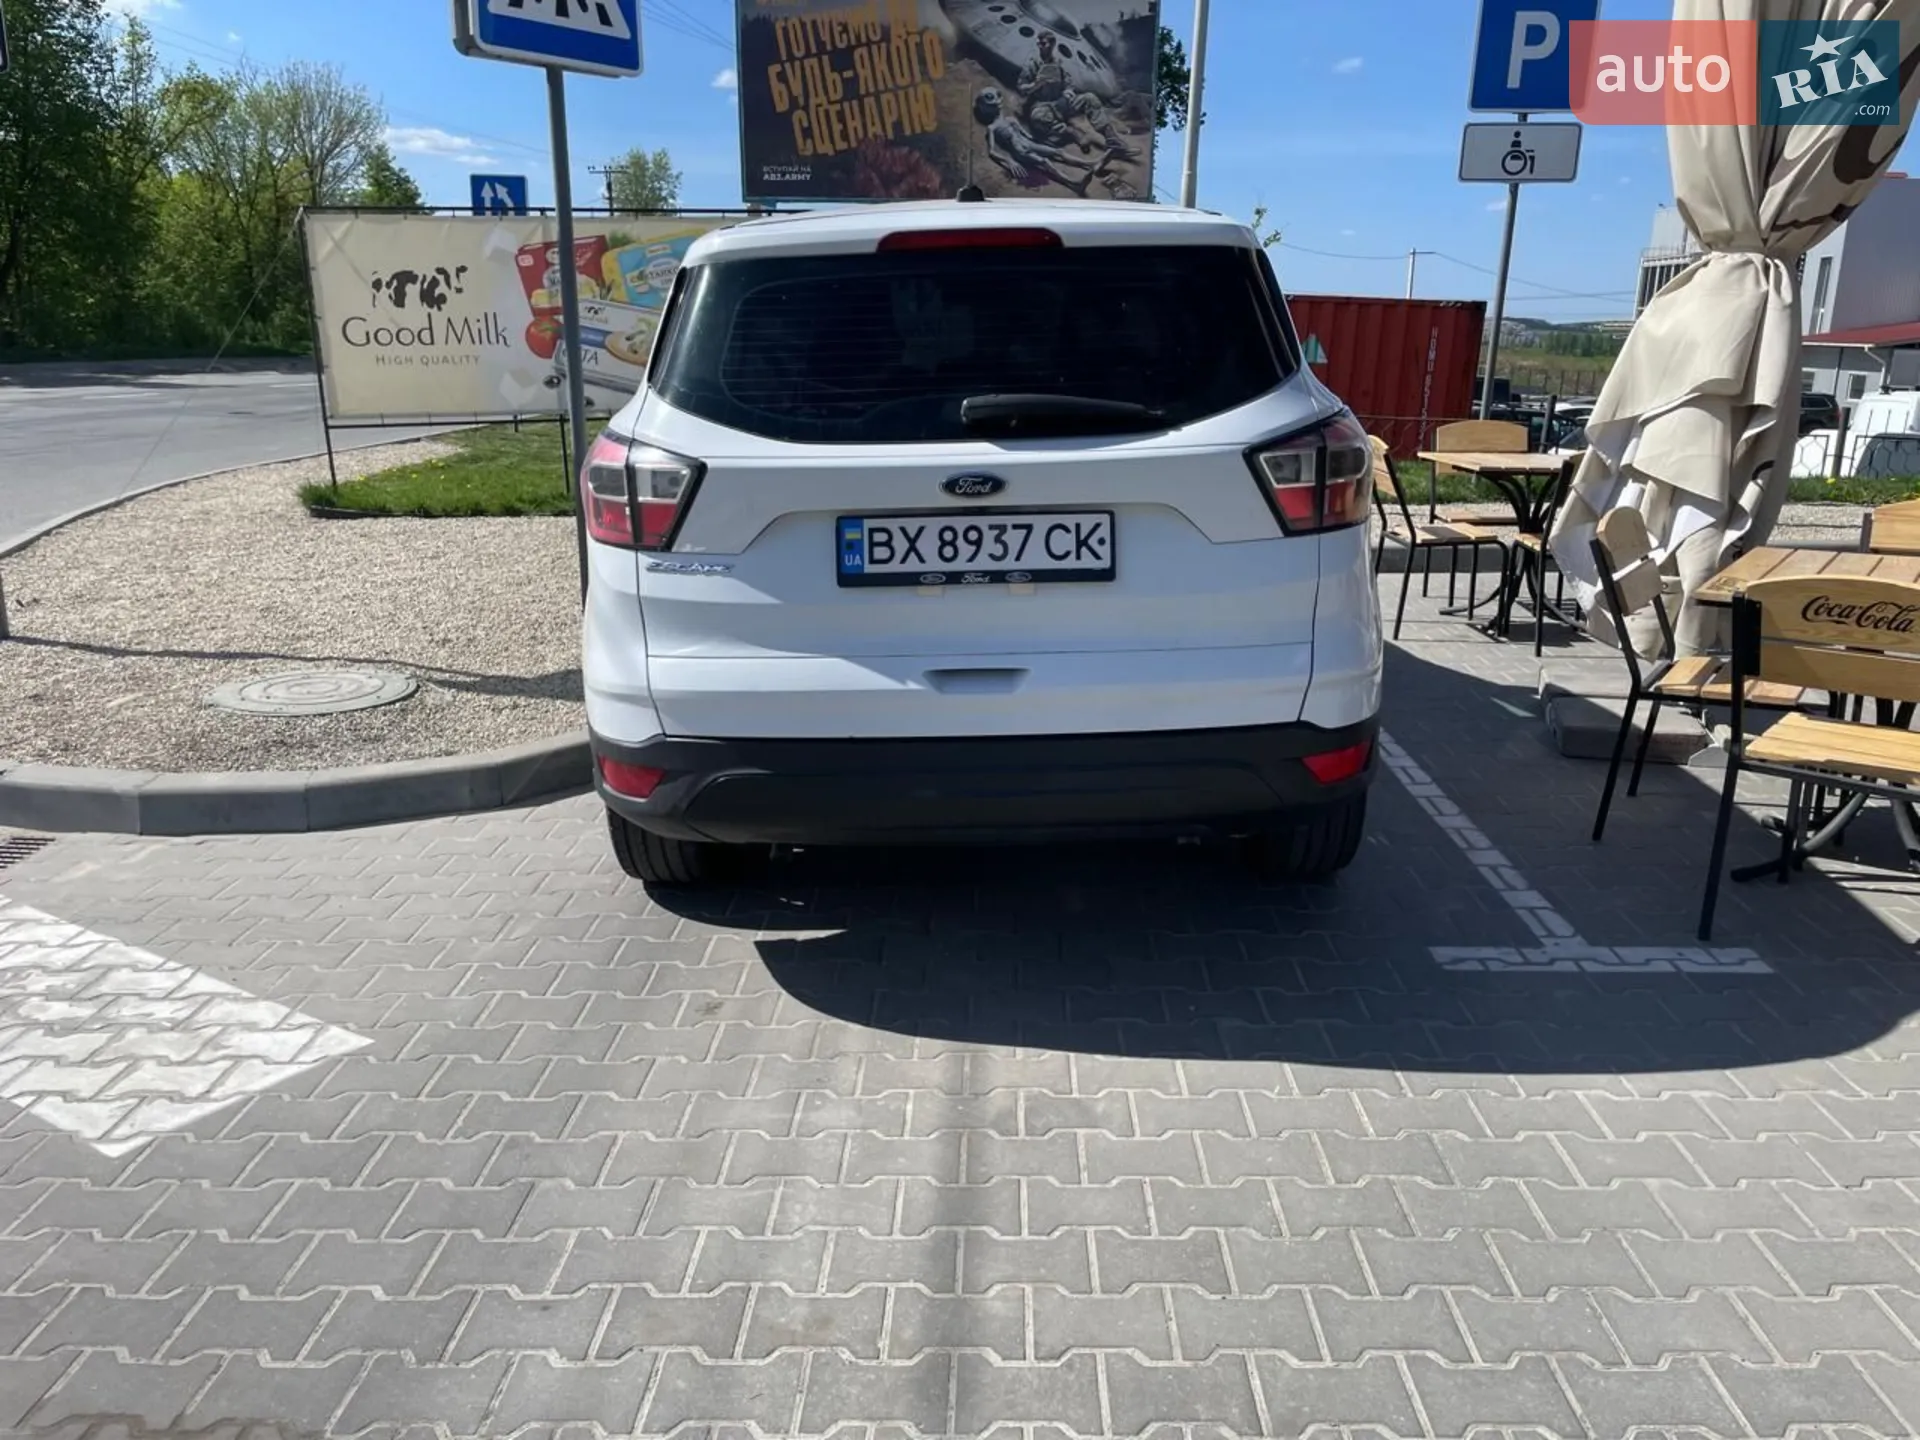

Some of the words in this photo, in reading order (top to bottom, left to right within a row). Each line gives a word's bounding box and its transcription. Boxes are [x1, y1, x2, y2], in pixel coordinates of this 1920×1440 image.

[767, 29, 945, 113] БУДЬ-ЯКОГО
[1506, 11, 1561, 89] P
[792, 83, 938, 156] СЦЕНАРІЮ
[341, 312, 435, 348] Good
[445, 312, 511, 348] Milk
[376, 355, 414, 366] HIGH
[420, 355, 481, 367] QUALITY
[844, 554, 863, 566] UA
[867, 525, 927, 566] BX
[937, 523, 1034, 564] 8937
[1044, 522, 1104, 562] CK
